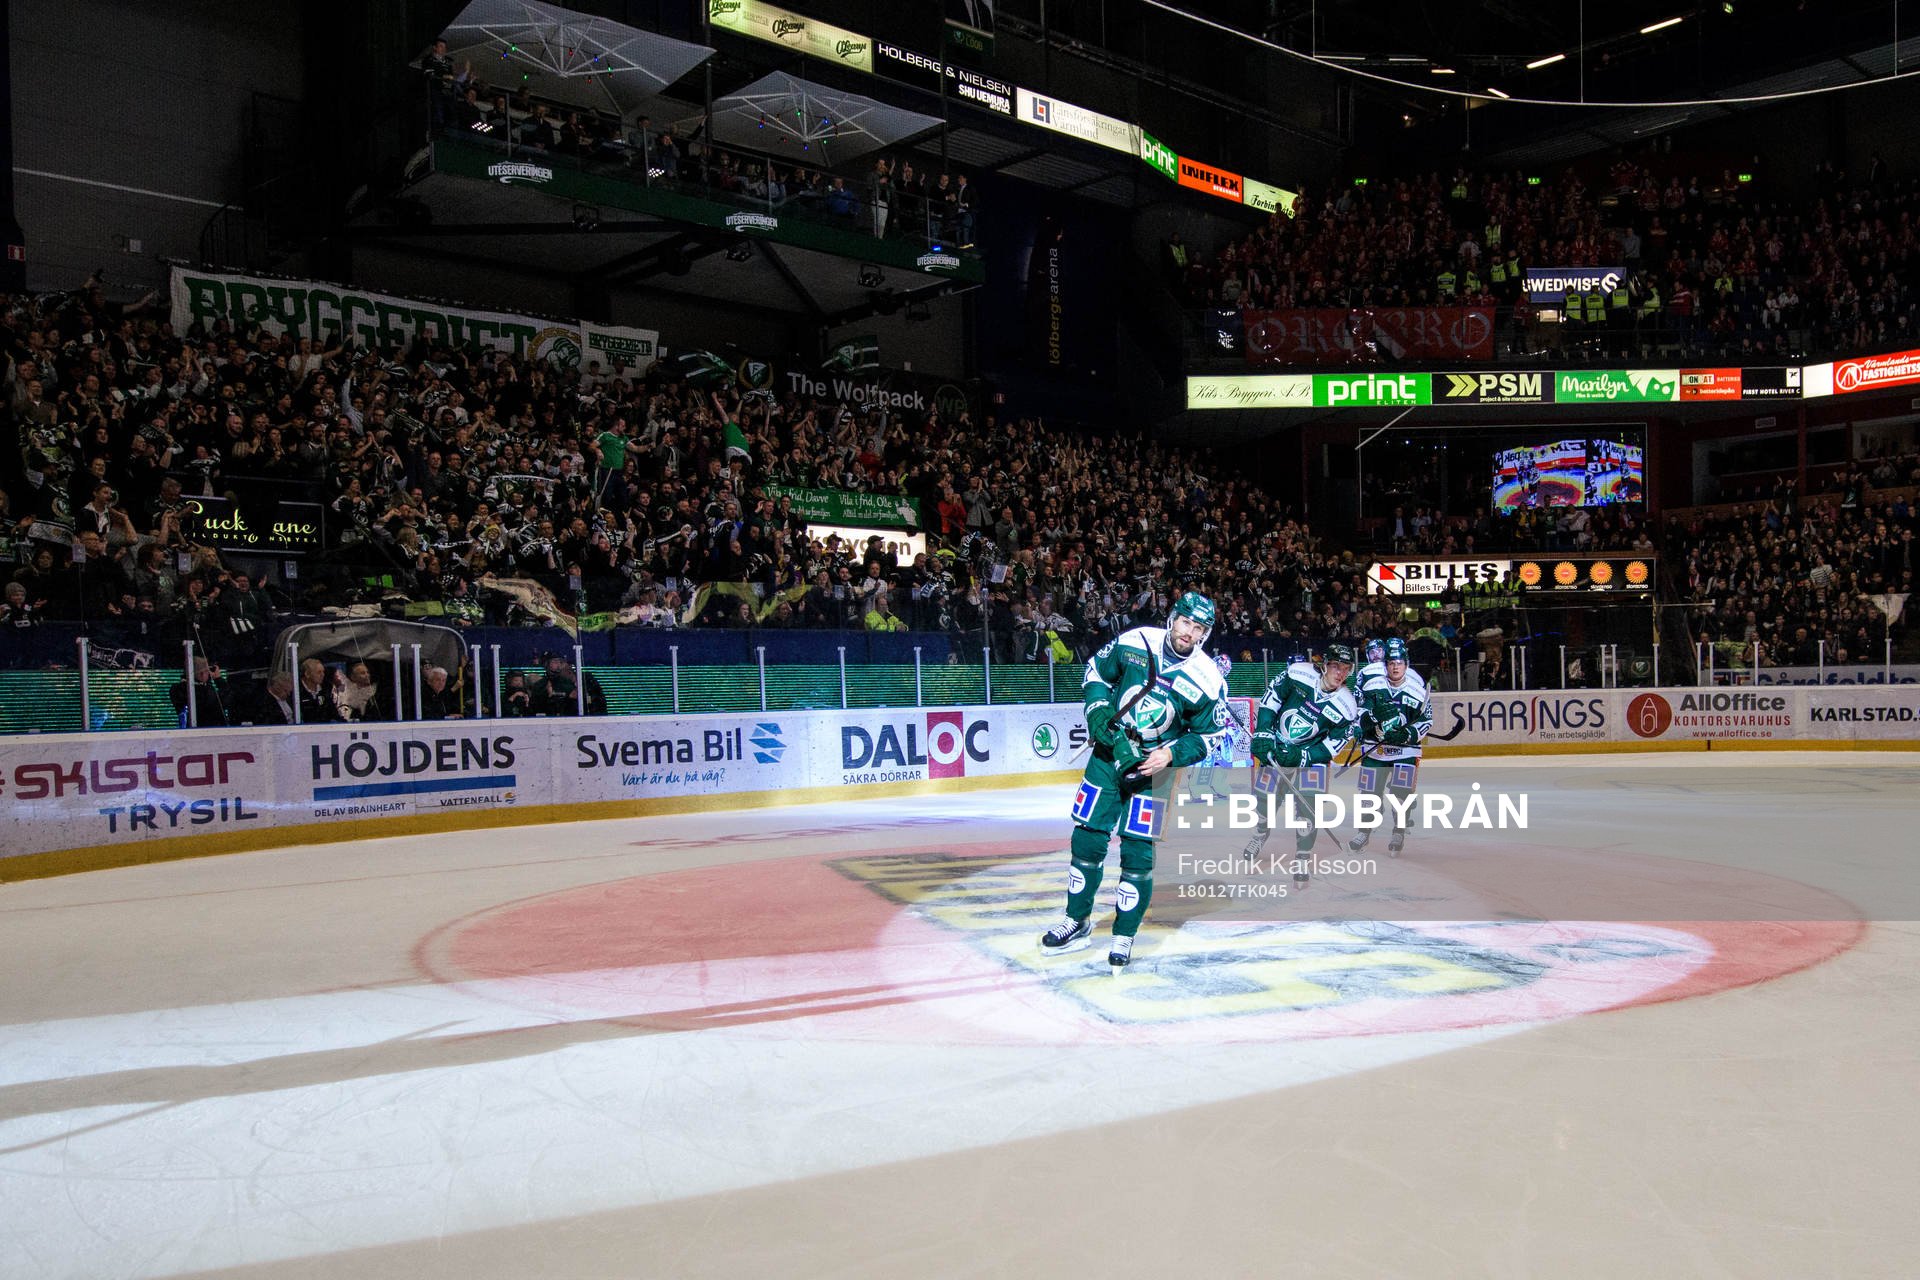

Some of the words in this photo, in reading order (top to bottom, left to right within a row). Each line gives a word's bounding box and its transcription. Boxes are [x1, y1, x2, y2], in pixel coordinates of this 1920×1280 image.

[878, 43, 941, 73] HOLBERG
[945, 66, 956, 78] &
[959, 71, 1011, 96] NIELSEN
[958, 84, 976, 98] SHU
[976, 90, 1011, 110] UEMURA
[1143, 138, 1175, 175] print
[1181, 163, 1239, 191] UNIFLEX
[787, 371, 828, 398] The
[832, 377, 925, 411] Wolfpack
[1328, 374, 1416, 406] print
[1480, 373, 1542, 397] PSM
[1561, 373, 1629, 399] Marilyn
[1743, 388, 1758, 396] FIRST
[1405, 562, 1498, 580] BILLES
[1405, 583, 1431, 592] Billes
[1680, 693, 1786, 711] AllOffice
[1674, 715, 1791, 727] KONTORSVARUHUS
[1810, 707, 1920, 722] KARLSTAD.
[1540, 731, 1556, 739] Ren
[1557, 729, 1606, 740] arbetsglädje
[1692, 729, 1773, 738] www.alloffice.se
[577, 735, 694, 769] Svema
[703, 728, 742, 762] Bil
[841, 719, 990, 770] DALOC
[311, 732, 516, 780] HÖJDENS
[650, 771, 664, 784] är
[665, 771, 680, 784] du
[683, 769, 699, 785] på
[843, 772, 878, 785] SÄKRA
[880, 770, 922, 782] DÖRRAR
[314, 808, 332, 818] DEL
[333, 807, 346, 816] AV
[347, 802, 407, 815] BRAINHEART
[440, 795, 503, 807] VATTENFALL
[99, 796, 259, 834] TRYSIL
